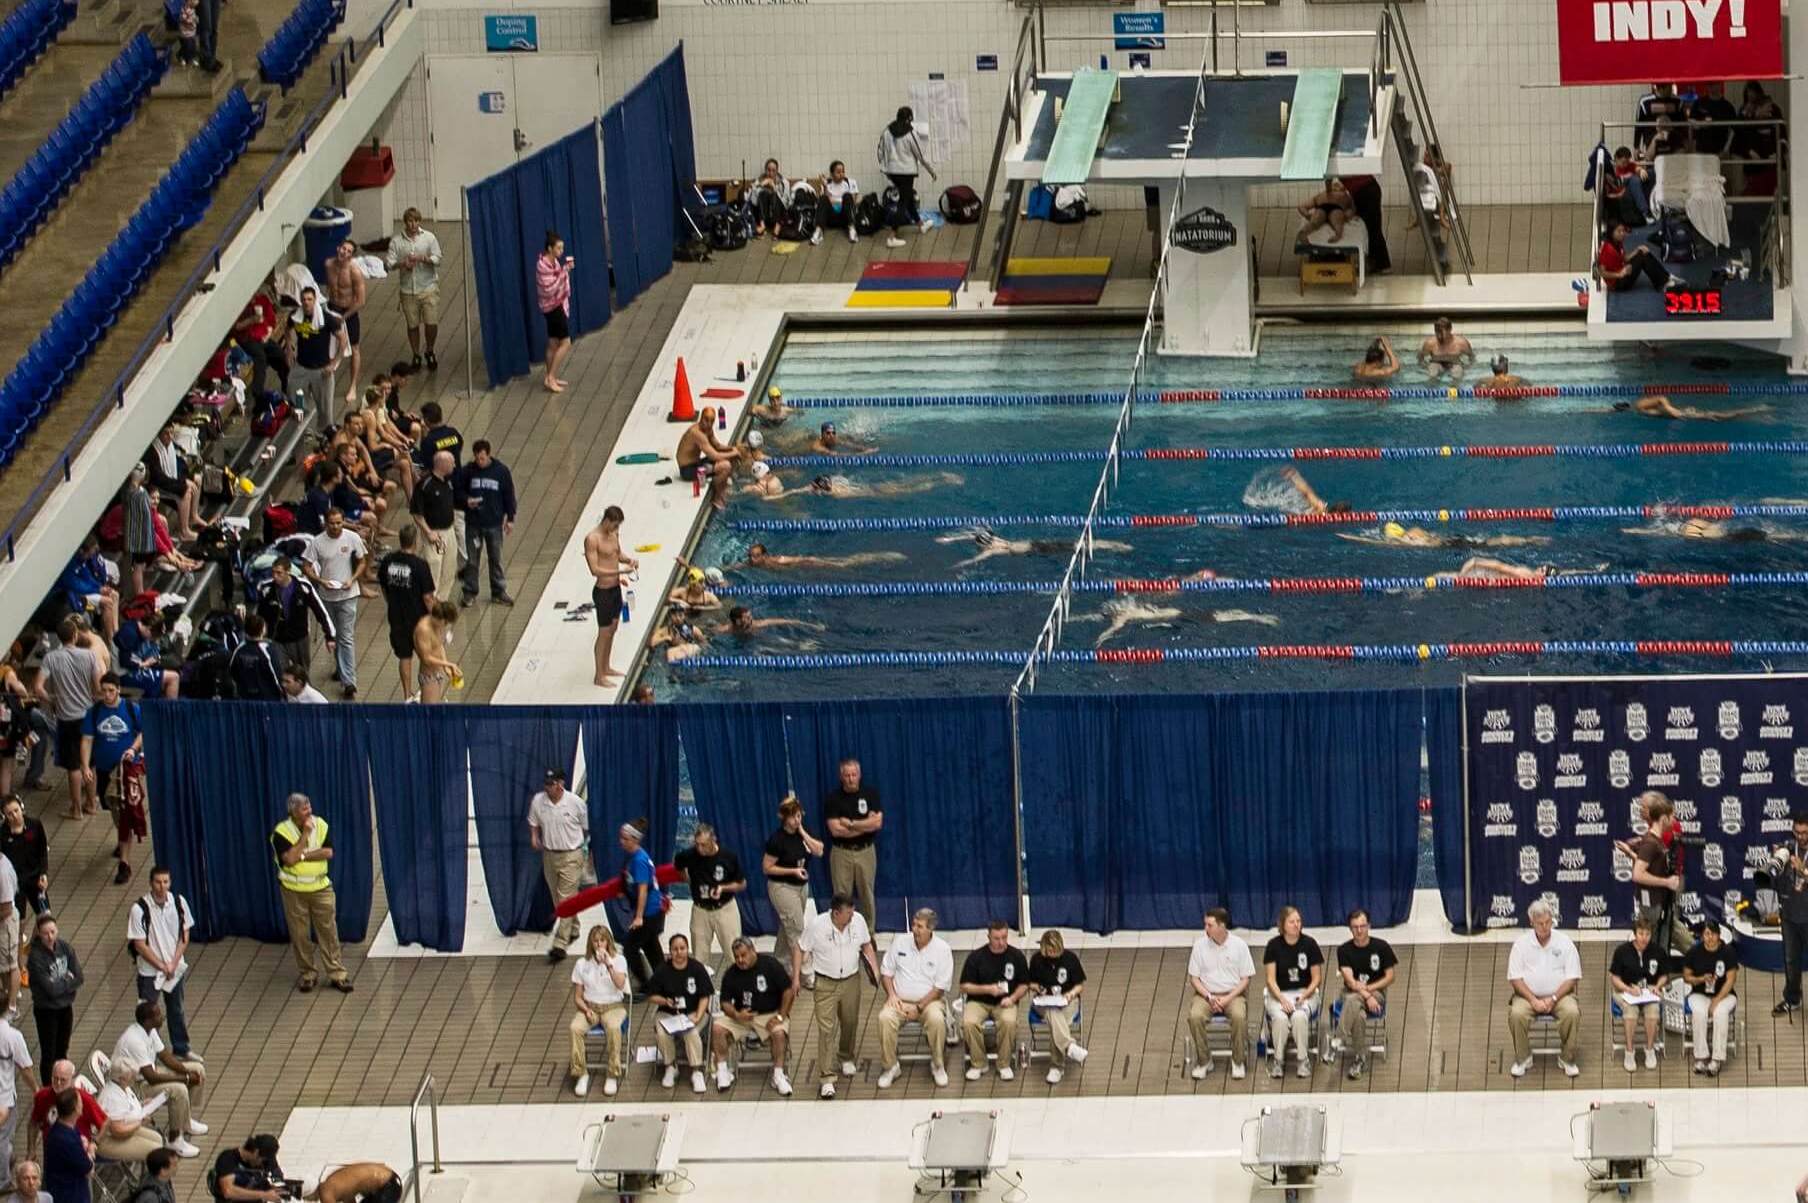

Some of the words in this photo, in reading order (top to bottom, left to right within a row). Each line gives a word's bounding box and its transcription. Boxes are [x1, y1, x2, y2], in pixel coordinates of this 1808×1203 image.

[496, 18, 527, 28] Doping
[496, 27, 527, 35] Control
[1176, 229, 1231, 241] NATATORIUM
